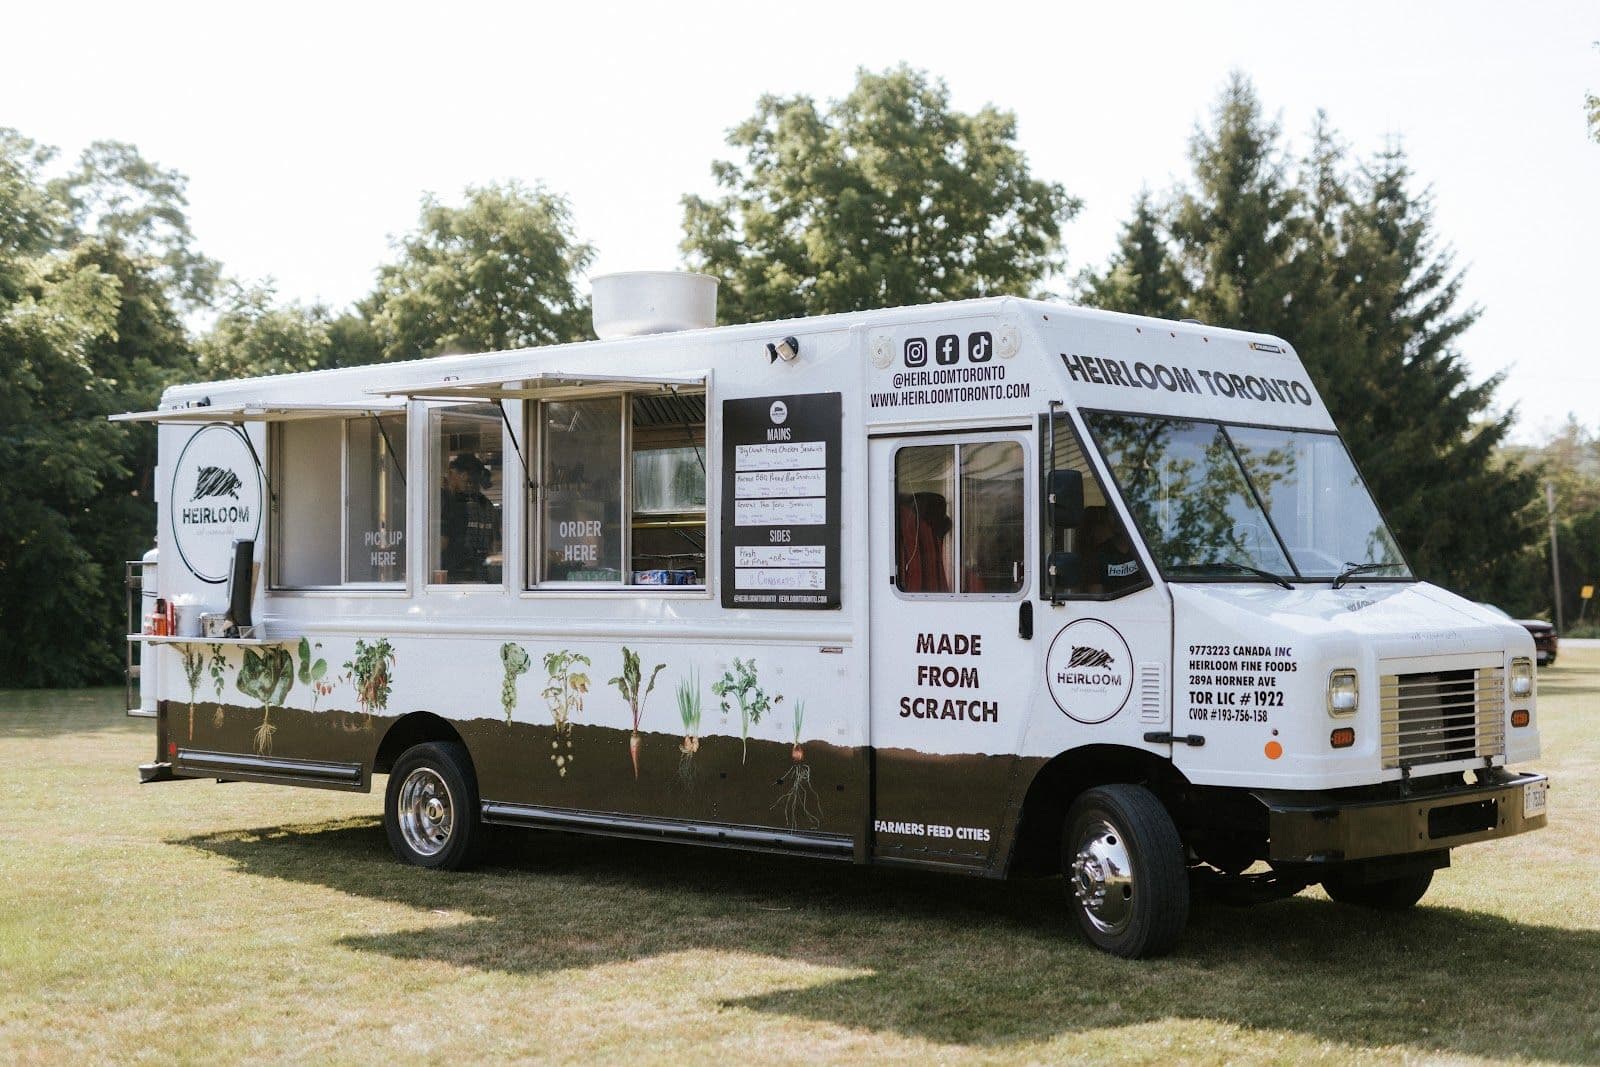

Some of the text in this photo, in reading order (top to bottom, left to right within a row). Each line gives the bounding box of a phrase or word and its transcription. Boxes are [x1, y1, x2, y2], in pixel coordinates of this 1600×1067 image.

[893, 365, 1005, 388] @HEIRLOOMTORONTO
[1060, 353, 1312, 406] HEIRLOOM TORONTO
[870, 383, 1030, 407] WWW.HEIRLOOMTORONTO.COM
[767, 427, 791, 441] MAINS
[183, 506, 249, 524] HEIRLOOM
[559, 520, 602, 537] ORDER
[769, 529, 791, 542] SIDES
[389, 531, 403, 545] UP
[370, 551, 397, 566] HERE
[564, 544, 597, 561] HERE
[916, 633, 982, 656] MADE
[1189, 646, 1292, 657] 9773223 CANADA INC
[1189, 660, 1297, 672] HEIRLOOM FINE FOODS
[917, 665, 979, 688] FROM
[1057, 672, 1122, 686] HEIRLOOM
[1189, 675, 1276, 687] 289A HORNER AVE
[1189, 691, 1213, 705] TOR
[1217, 692, 1235, 705] LIC
[899, 696, 998, 723] SCRATCH
[1189, 708, 1208, 720] CVOR
[874, 820, 991, 841] FARMERS FEED CITIES
